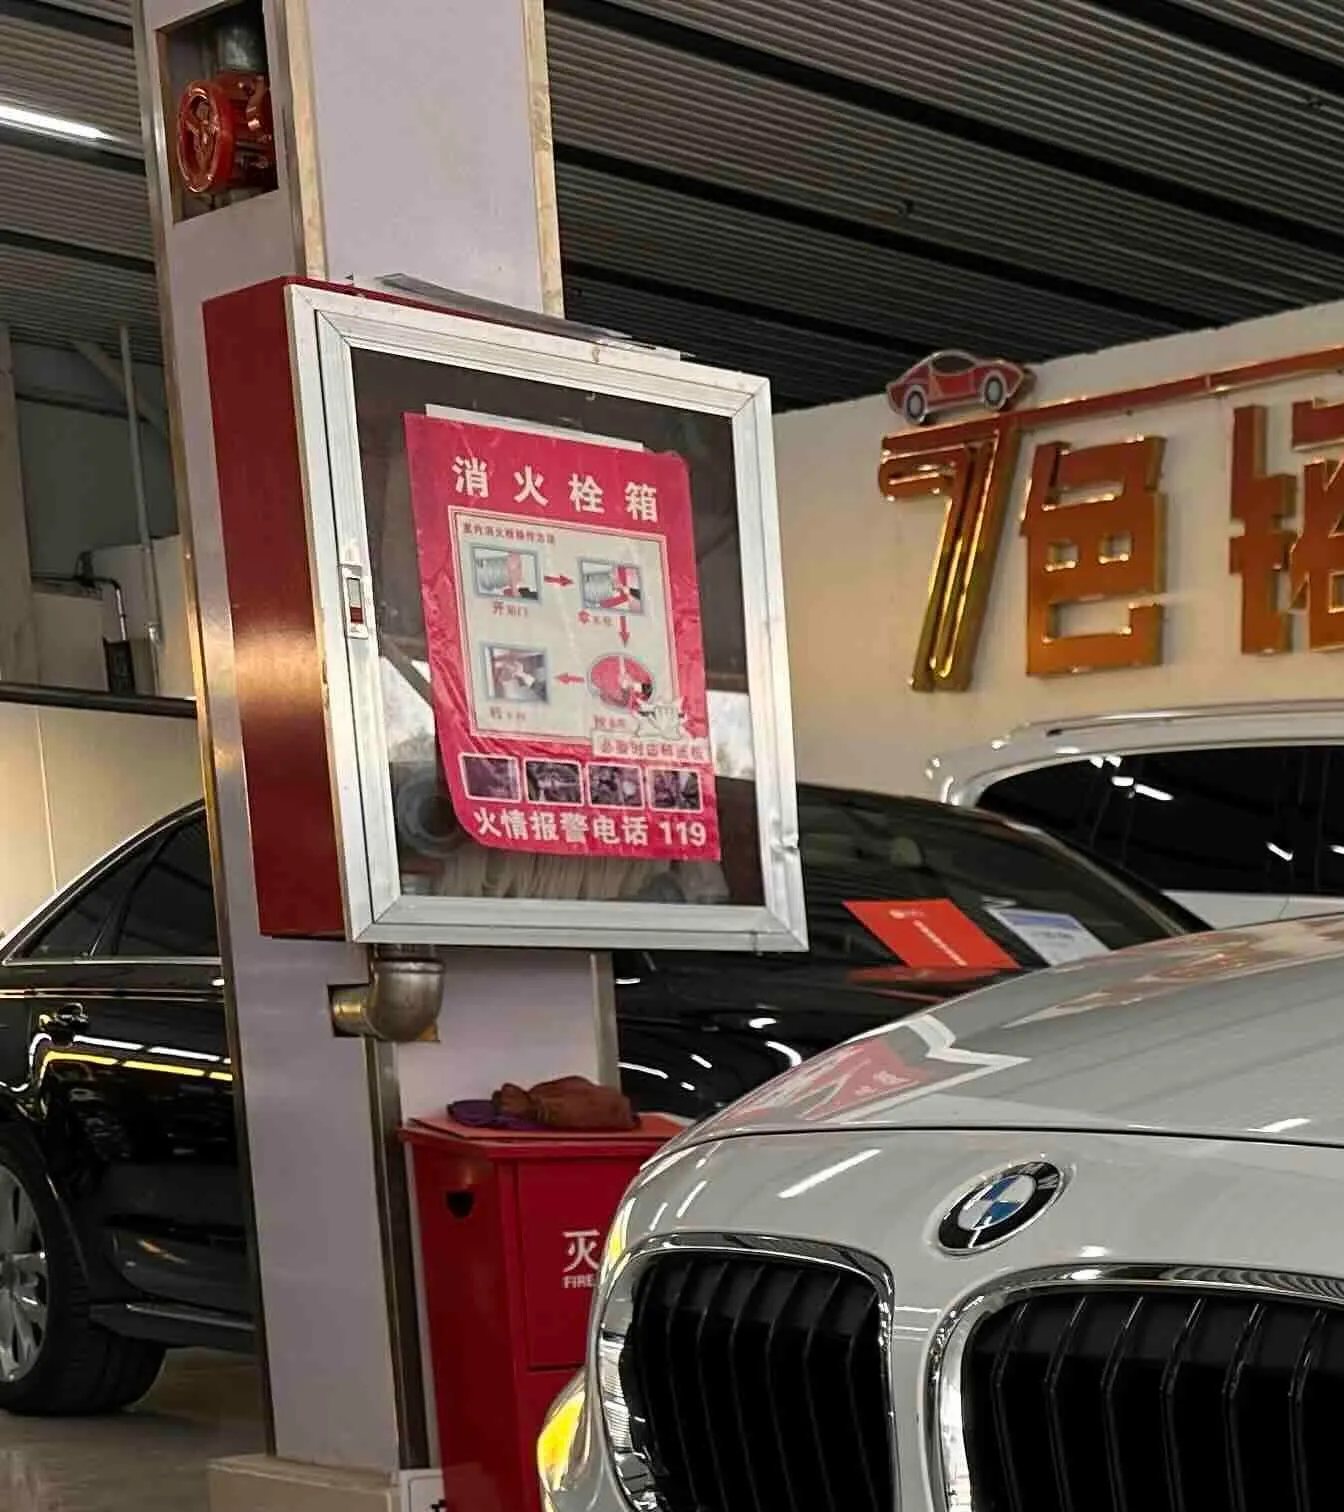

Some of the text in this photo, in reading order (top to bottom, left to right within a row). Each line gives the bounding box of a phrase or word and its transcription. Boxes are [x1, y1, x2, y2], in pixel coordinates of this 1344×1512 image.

[452, 456, 657, 522] 消火栓箱
[474, 807, 707, 847] 火情报警电话 119
